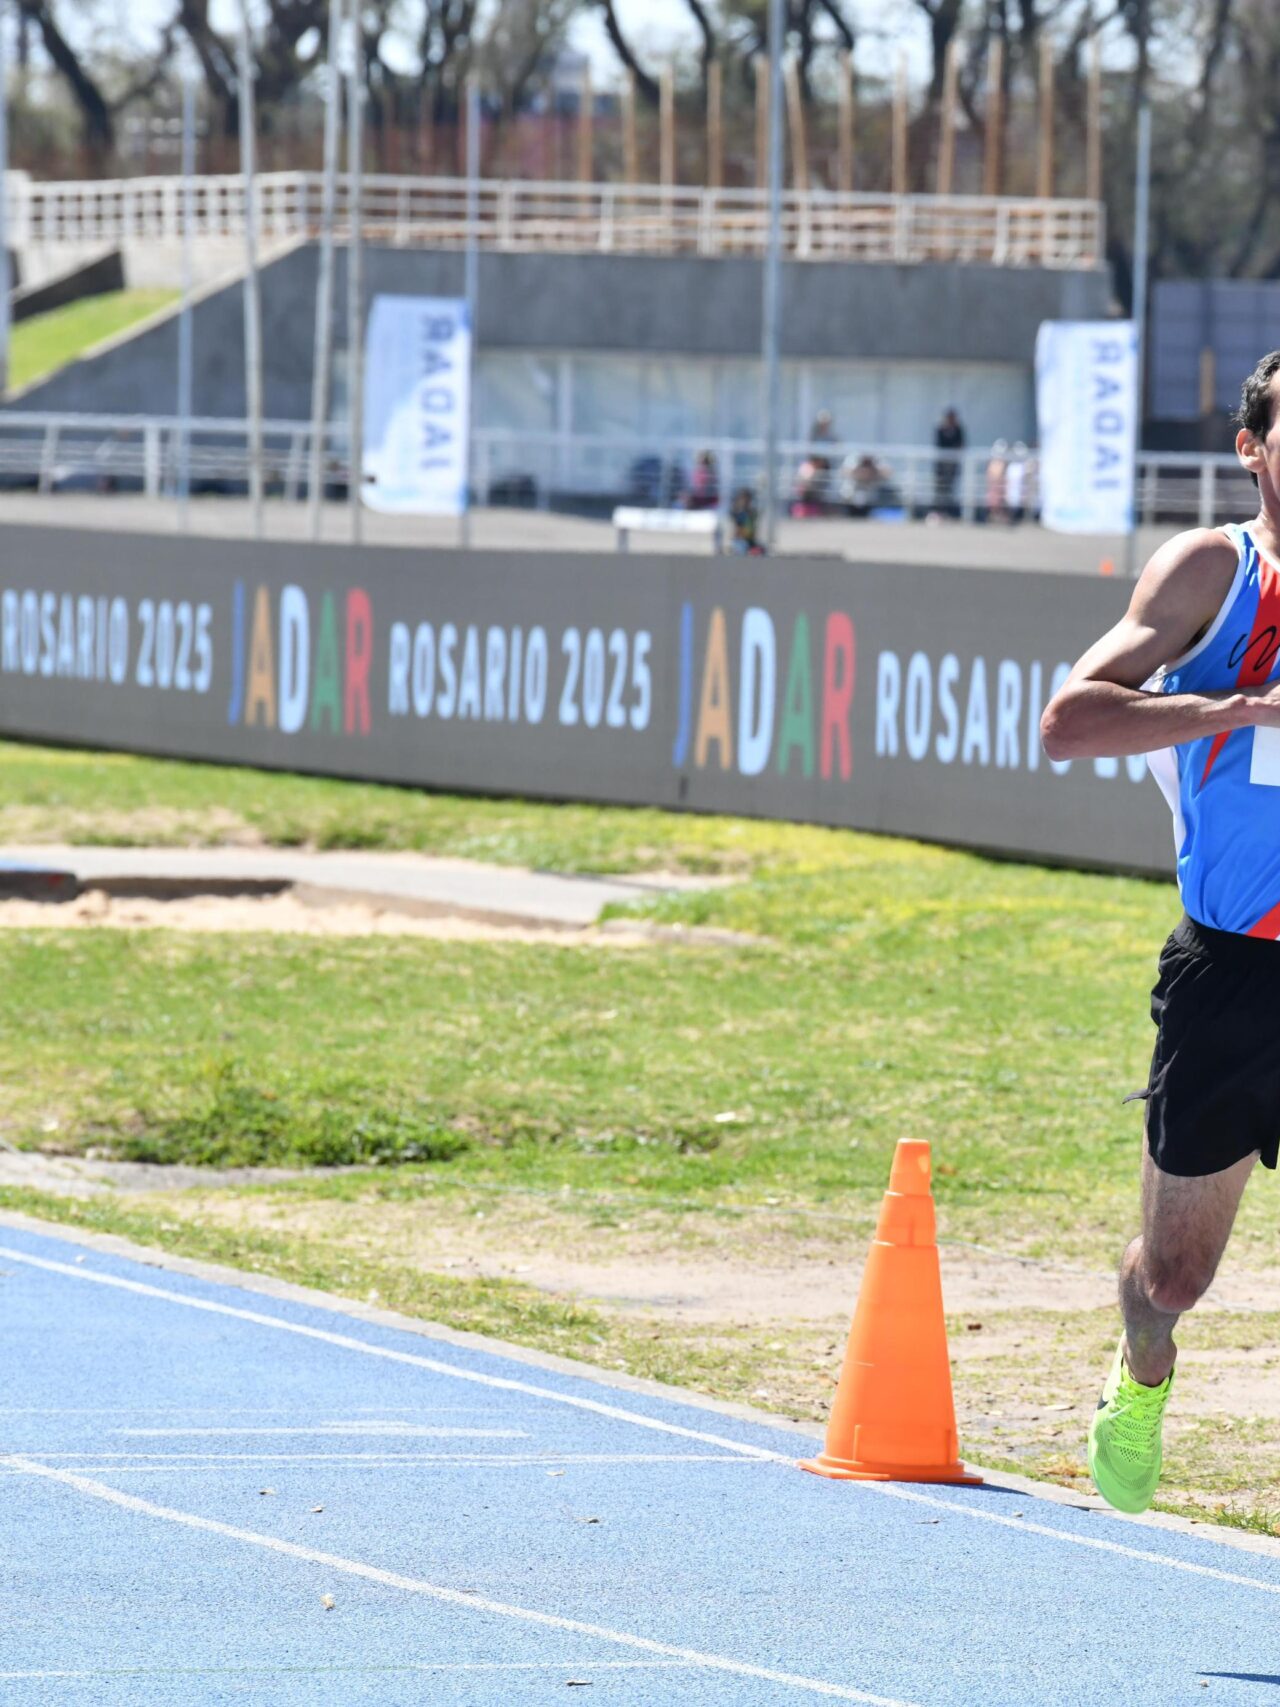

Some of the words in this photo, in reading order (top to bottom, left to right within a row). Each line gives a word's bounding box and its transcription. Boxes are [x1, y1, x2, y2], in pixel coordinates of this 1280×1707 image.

[2, 588, 128, 685] ROSARIO
[136, 598, 213, 693] 2025
[228, 579, 374, 736] JADAR
[388, 621, 548, 725] ROSARIO
[559, 627, 652, 731] 2025
[672, 601, 856, 782] JADAR
